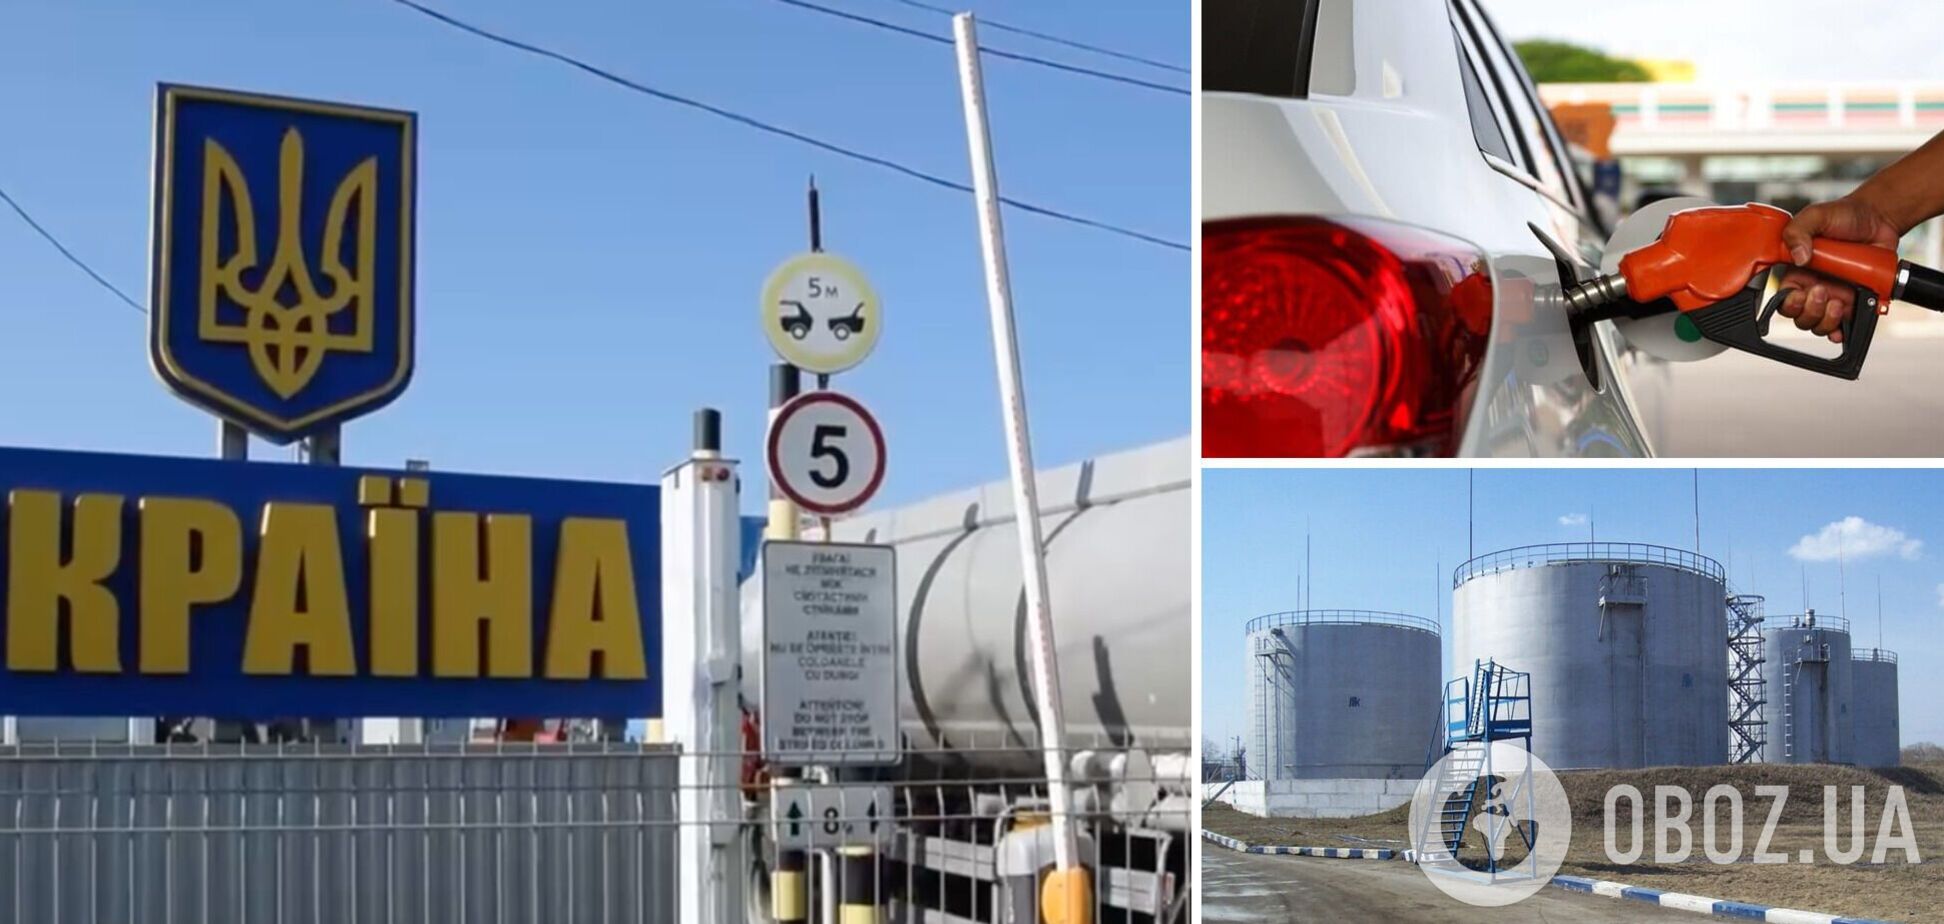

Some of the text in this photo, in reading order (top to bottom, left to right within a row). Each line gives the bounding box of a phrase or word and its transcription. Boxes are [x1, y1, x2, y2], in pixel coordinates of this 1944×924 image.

[808, 278, 822, 298] 5
[809, 425, 849, 489] 5
[7, 475, 647, 680] КРАЇНА
[823, 806, 839, 834] 8
